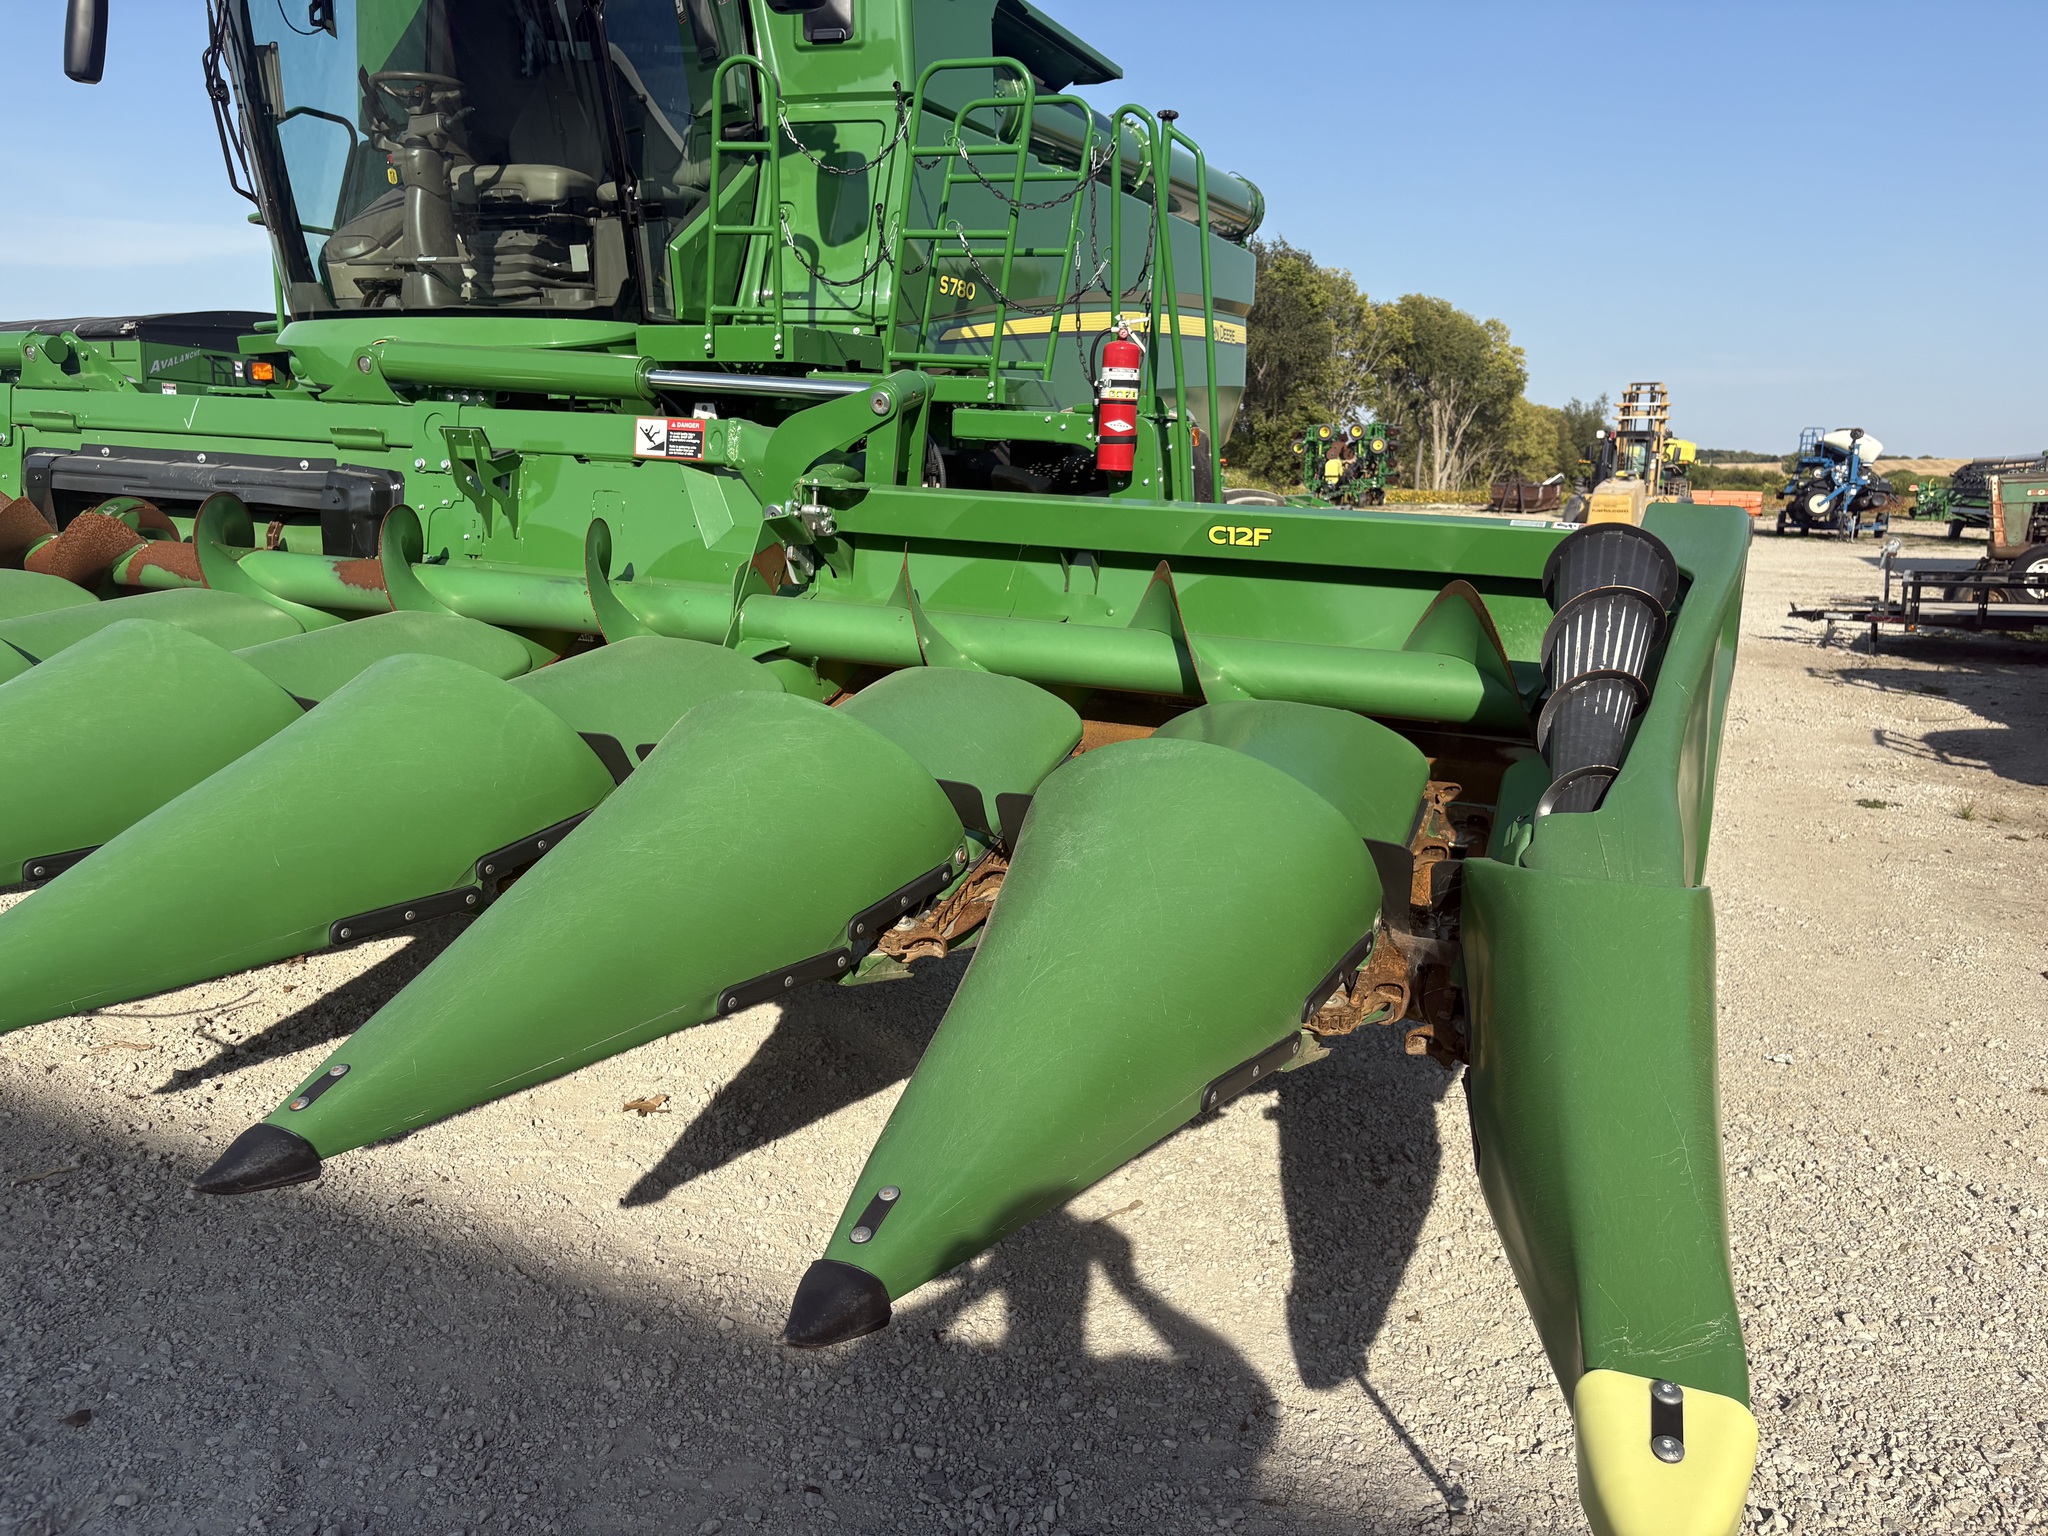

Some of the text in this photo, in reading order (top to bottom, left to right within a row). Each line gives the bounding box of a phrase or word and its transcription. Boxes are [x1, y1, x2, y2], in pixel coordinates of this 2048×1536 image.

[939, 275, 976, 300] S780
[150, 349, 201, 374] AVALANCHE
[1208, 525, 1273, 547] C12F
